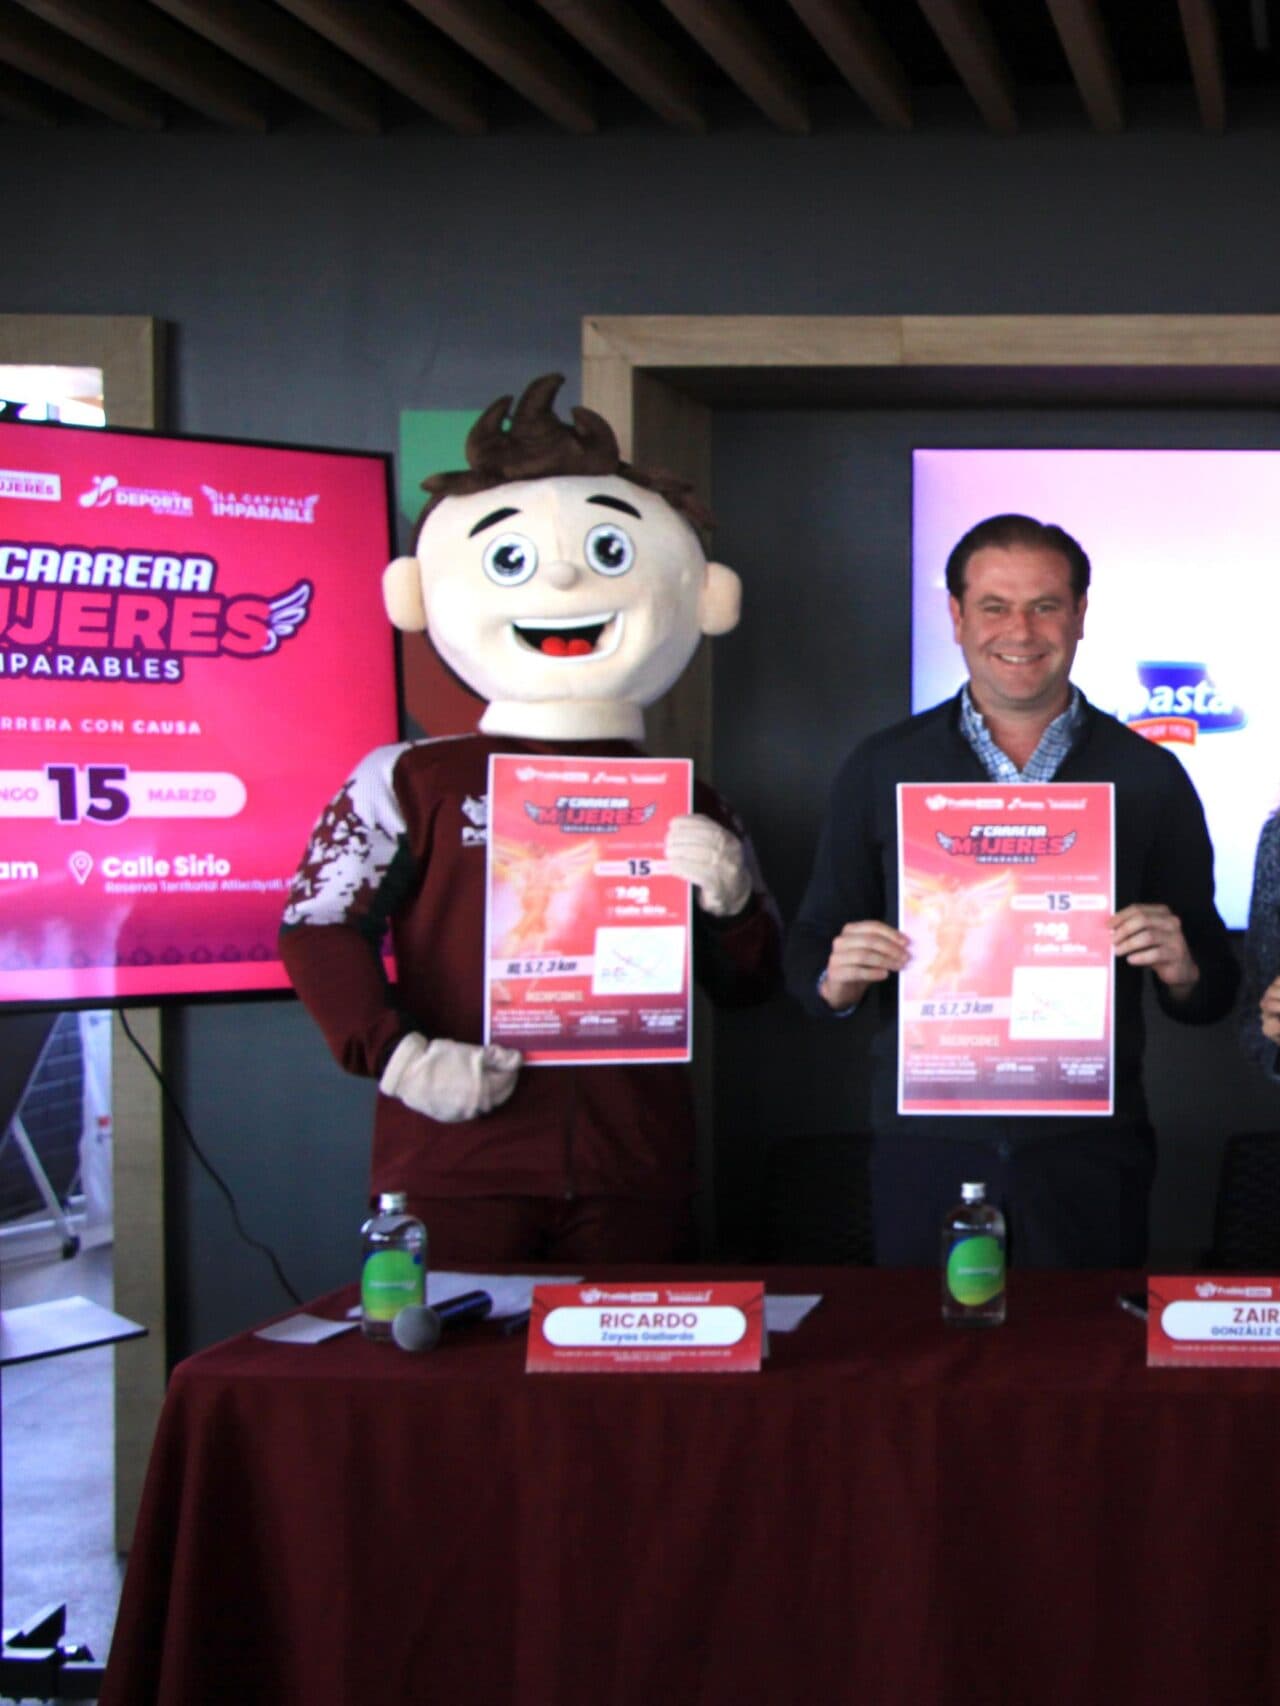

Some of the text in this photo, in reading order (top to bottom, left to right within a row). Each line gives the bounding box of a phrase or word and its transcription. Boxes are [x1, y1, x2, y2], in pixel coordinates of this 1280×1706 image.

[115, 493, 193, 511] DEPORTE
[213, 502, 315, 523] IMPARABLE
[0, 546, 214, 592] CARRERA
[81, 719, 124, 733] CON
[133, 719, 200, 735] CAUSA
[47, 765, 131, 822] 15
[148, 788, 217, 803] MARZO
[952, 836, 1064, 855] MUJERES
[101, 853, 231, 878] Calle Sirio
[629, 860, 650, 875] 15
[1047, 894, 1071, 911] 15
[600, 1312, 698, 1329] RICARDO
[601, 1331, 695, 1344] Zayas Gallardo
[1211, 1323, 1271, 1337] GONZÁLEZ
